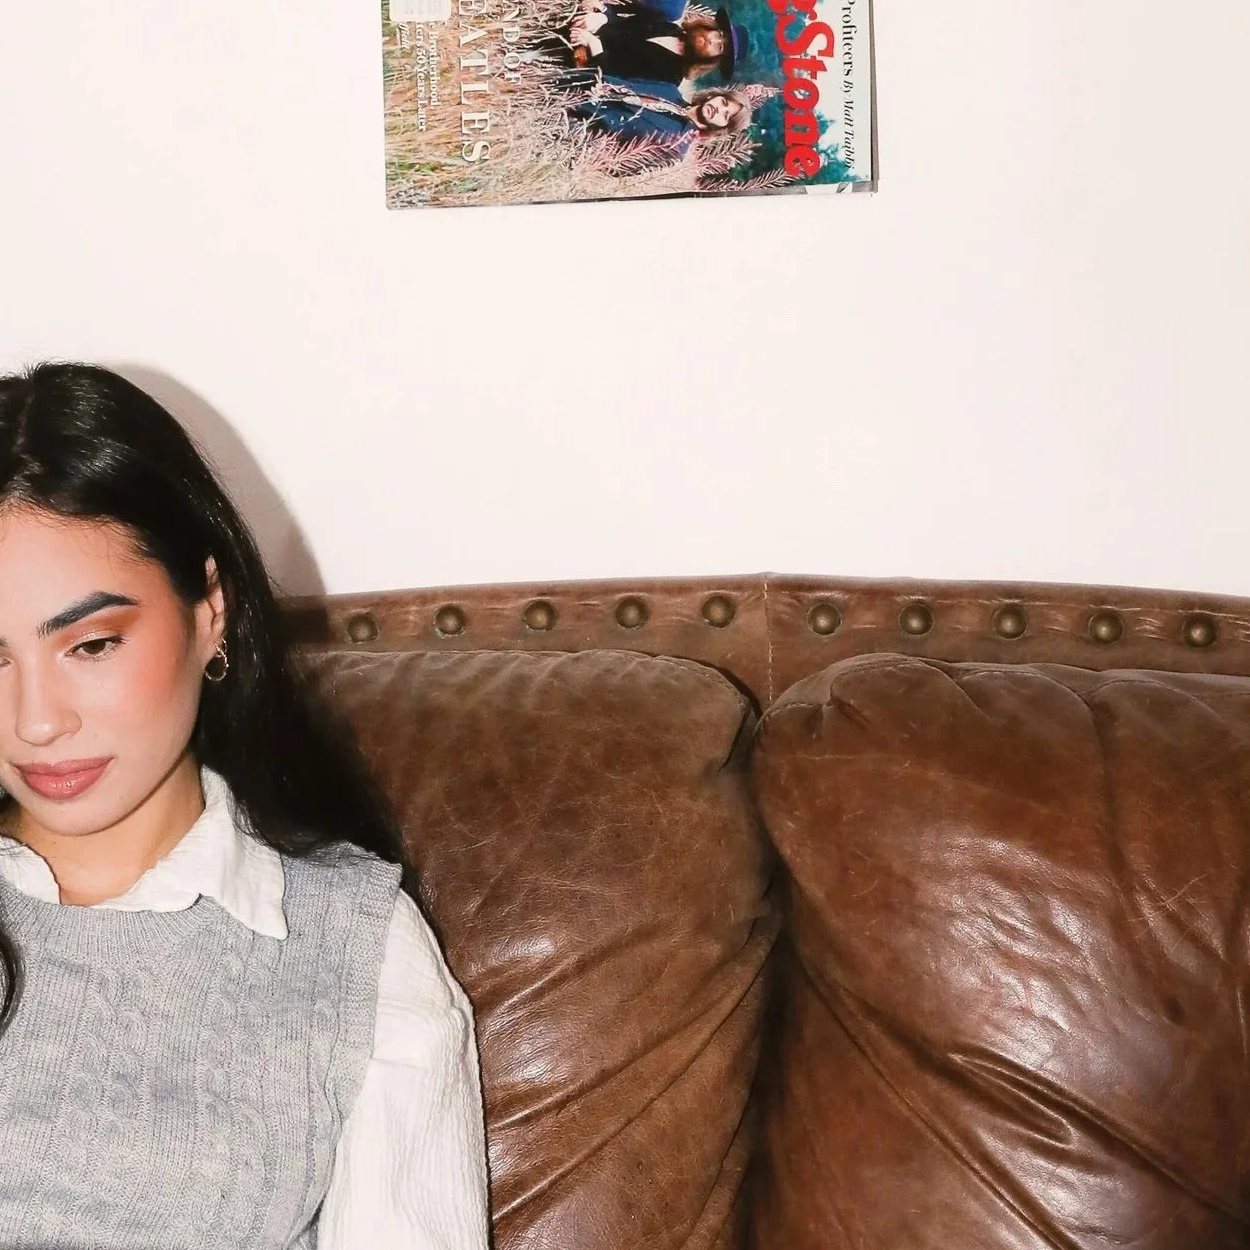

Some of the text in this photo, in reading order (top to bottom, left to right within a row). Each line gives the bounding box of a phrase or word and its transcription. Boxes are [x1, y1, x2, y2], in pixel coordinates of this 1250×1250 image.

[416, 48, 427, 64] 50
[416, 65, 428, 98] Years
[840, 80, 854, 94] By
[417, 100, 428, 132] Later
[844, 100, 855, 127] Matt
